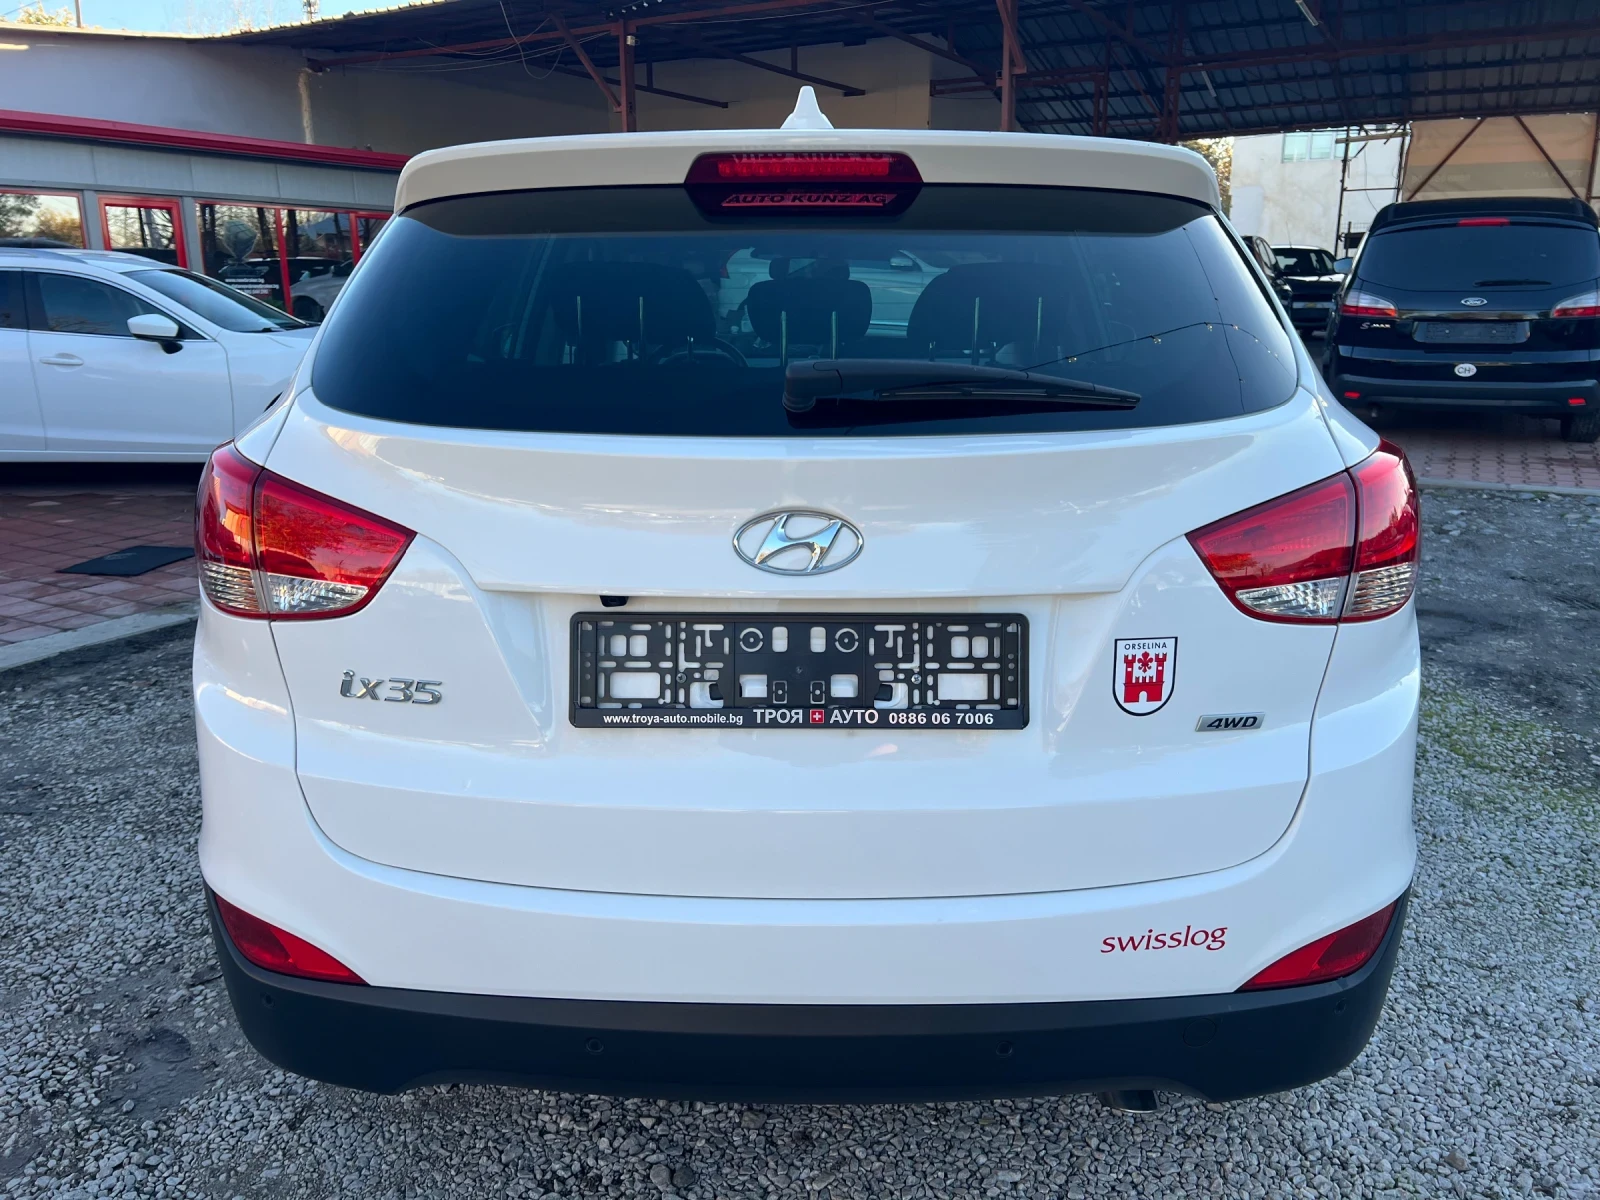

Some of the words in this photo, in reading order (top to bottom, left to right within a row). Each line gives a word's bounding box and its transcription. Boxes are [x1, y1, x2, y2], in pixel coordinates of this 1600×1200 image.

[726, 194, 785, 204] AUTO
[791, 194, 854, 203] KUNZ
[856, 194, 887, 204] AG
[1457, 366, 1471, 375] CH
[1124, 641, 1168, 651] ORSELINA
[340, 668, 443, 705] ix35
[602, 712, 744, 726] www.troya-auto.mobile.bg
[753, 709, 804, 724] ТРОЯ
[829, 709, 879, 724] АУТО
[888, 712, 927, 726] 0886
[931, 712, 951, 726] 06
[956, 712, 995, 726] 7006
[1206, 716, 1258, 729] 4WD
[1100, 925, 1228, 954] swisslog
